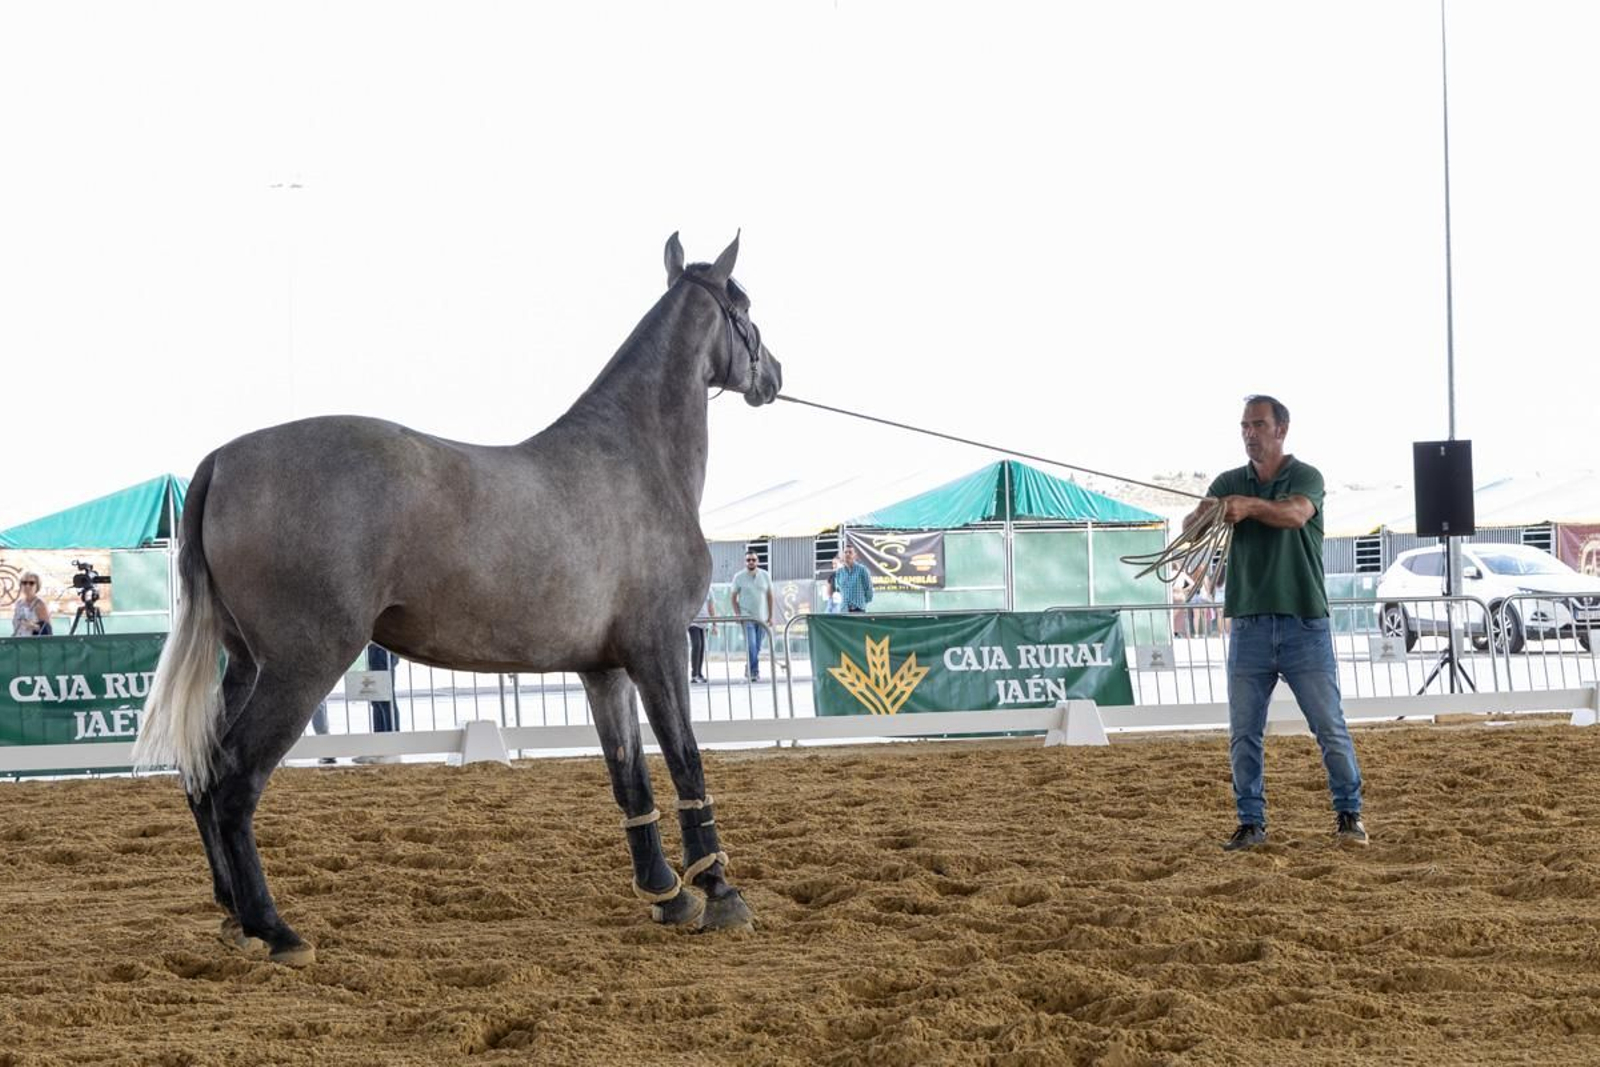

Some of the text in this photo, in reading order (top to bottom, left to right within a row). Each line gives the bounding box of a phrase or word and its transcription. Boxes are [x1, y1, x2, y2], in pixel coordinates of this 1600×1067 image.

[943, 643, 1112, 672] CAJA RURAL
[9, 671, 157, 703] CAJA RU
[995, 675, 1067, 705] JAÉN
